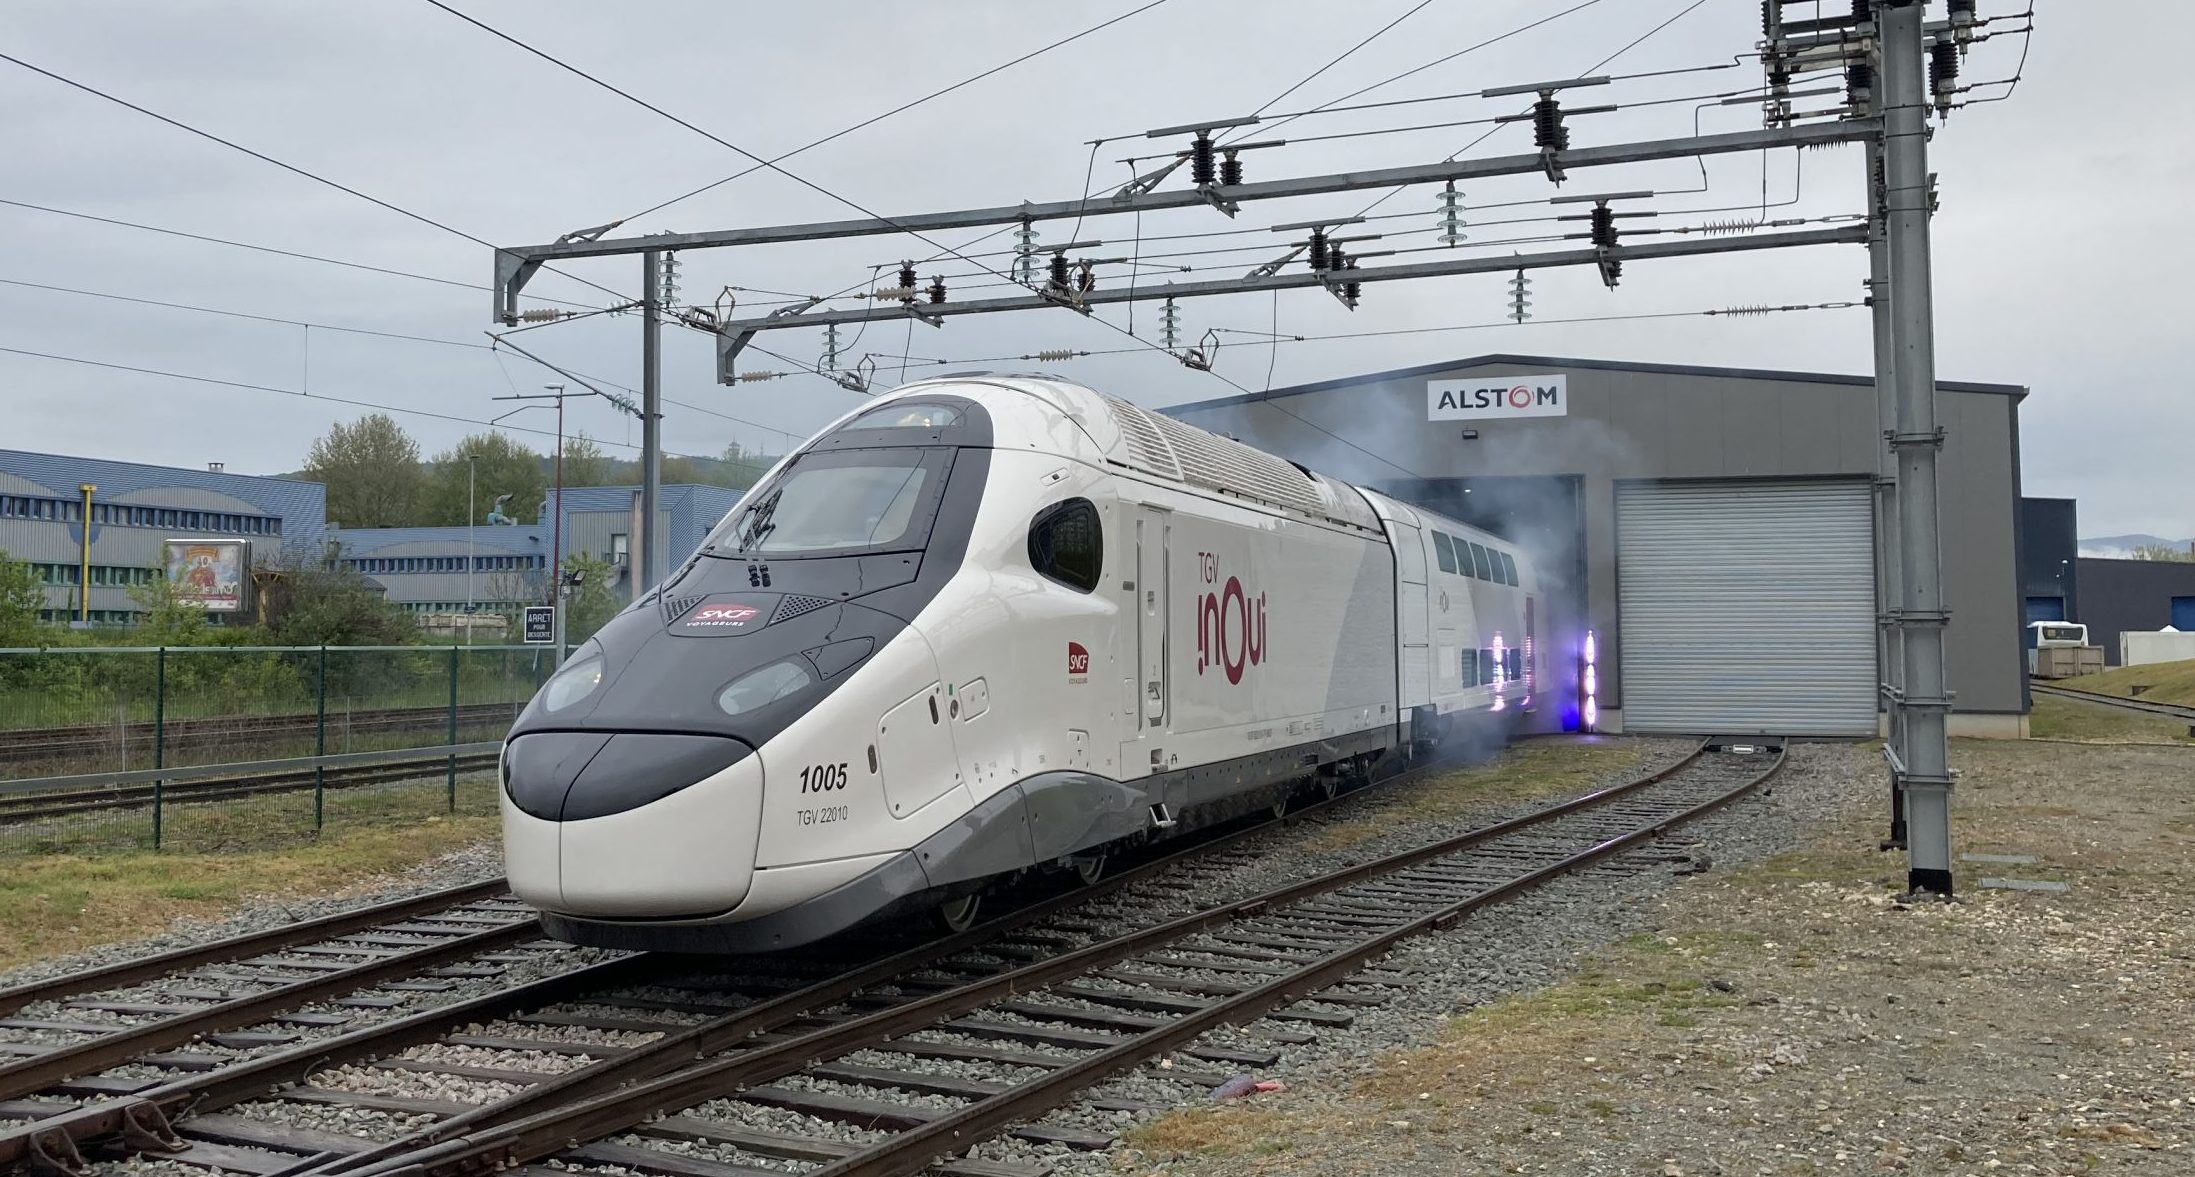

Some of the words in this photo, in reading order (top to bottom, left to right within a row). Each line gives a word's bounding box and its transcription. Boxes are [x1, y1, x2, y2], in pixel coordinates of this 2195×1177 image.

[1438, 385, 1557, 410] ALSTOM
[1198, 552, 1220, 584] TGV
[695, 609, 757, 619] SNCF
[1069, 654, 1088, 670] SNCF
[800, 763, 848, 794] 1005
[797, 809, 819, 827] TGV
[820, 805, 848, 823] 22010
